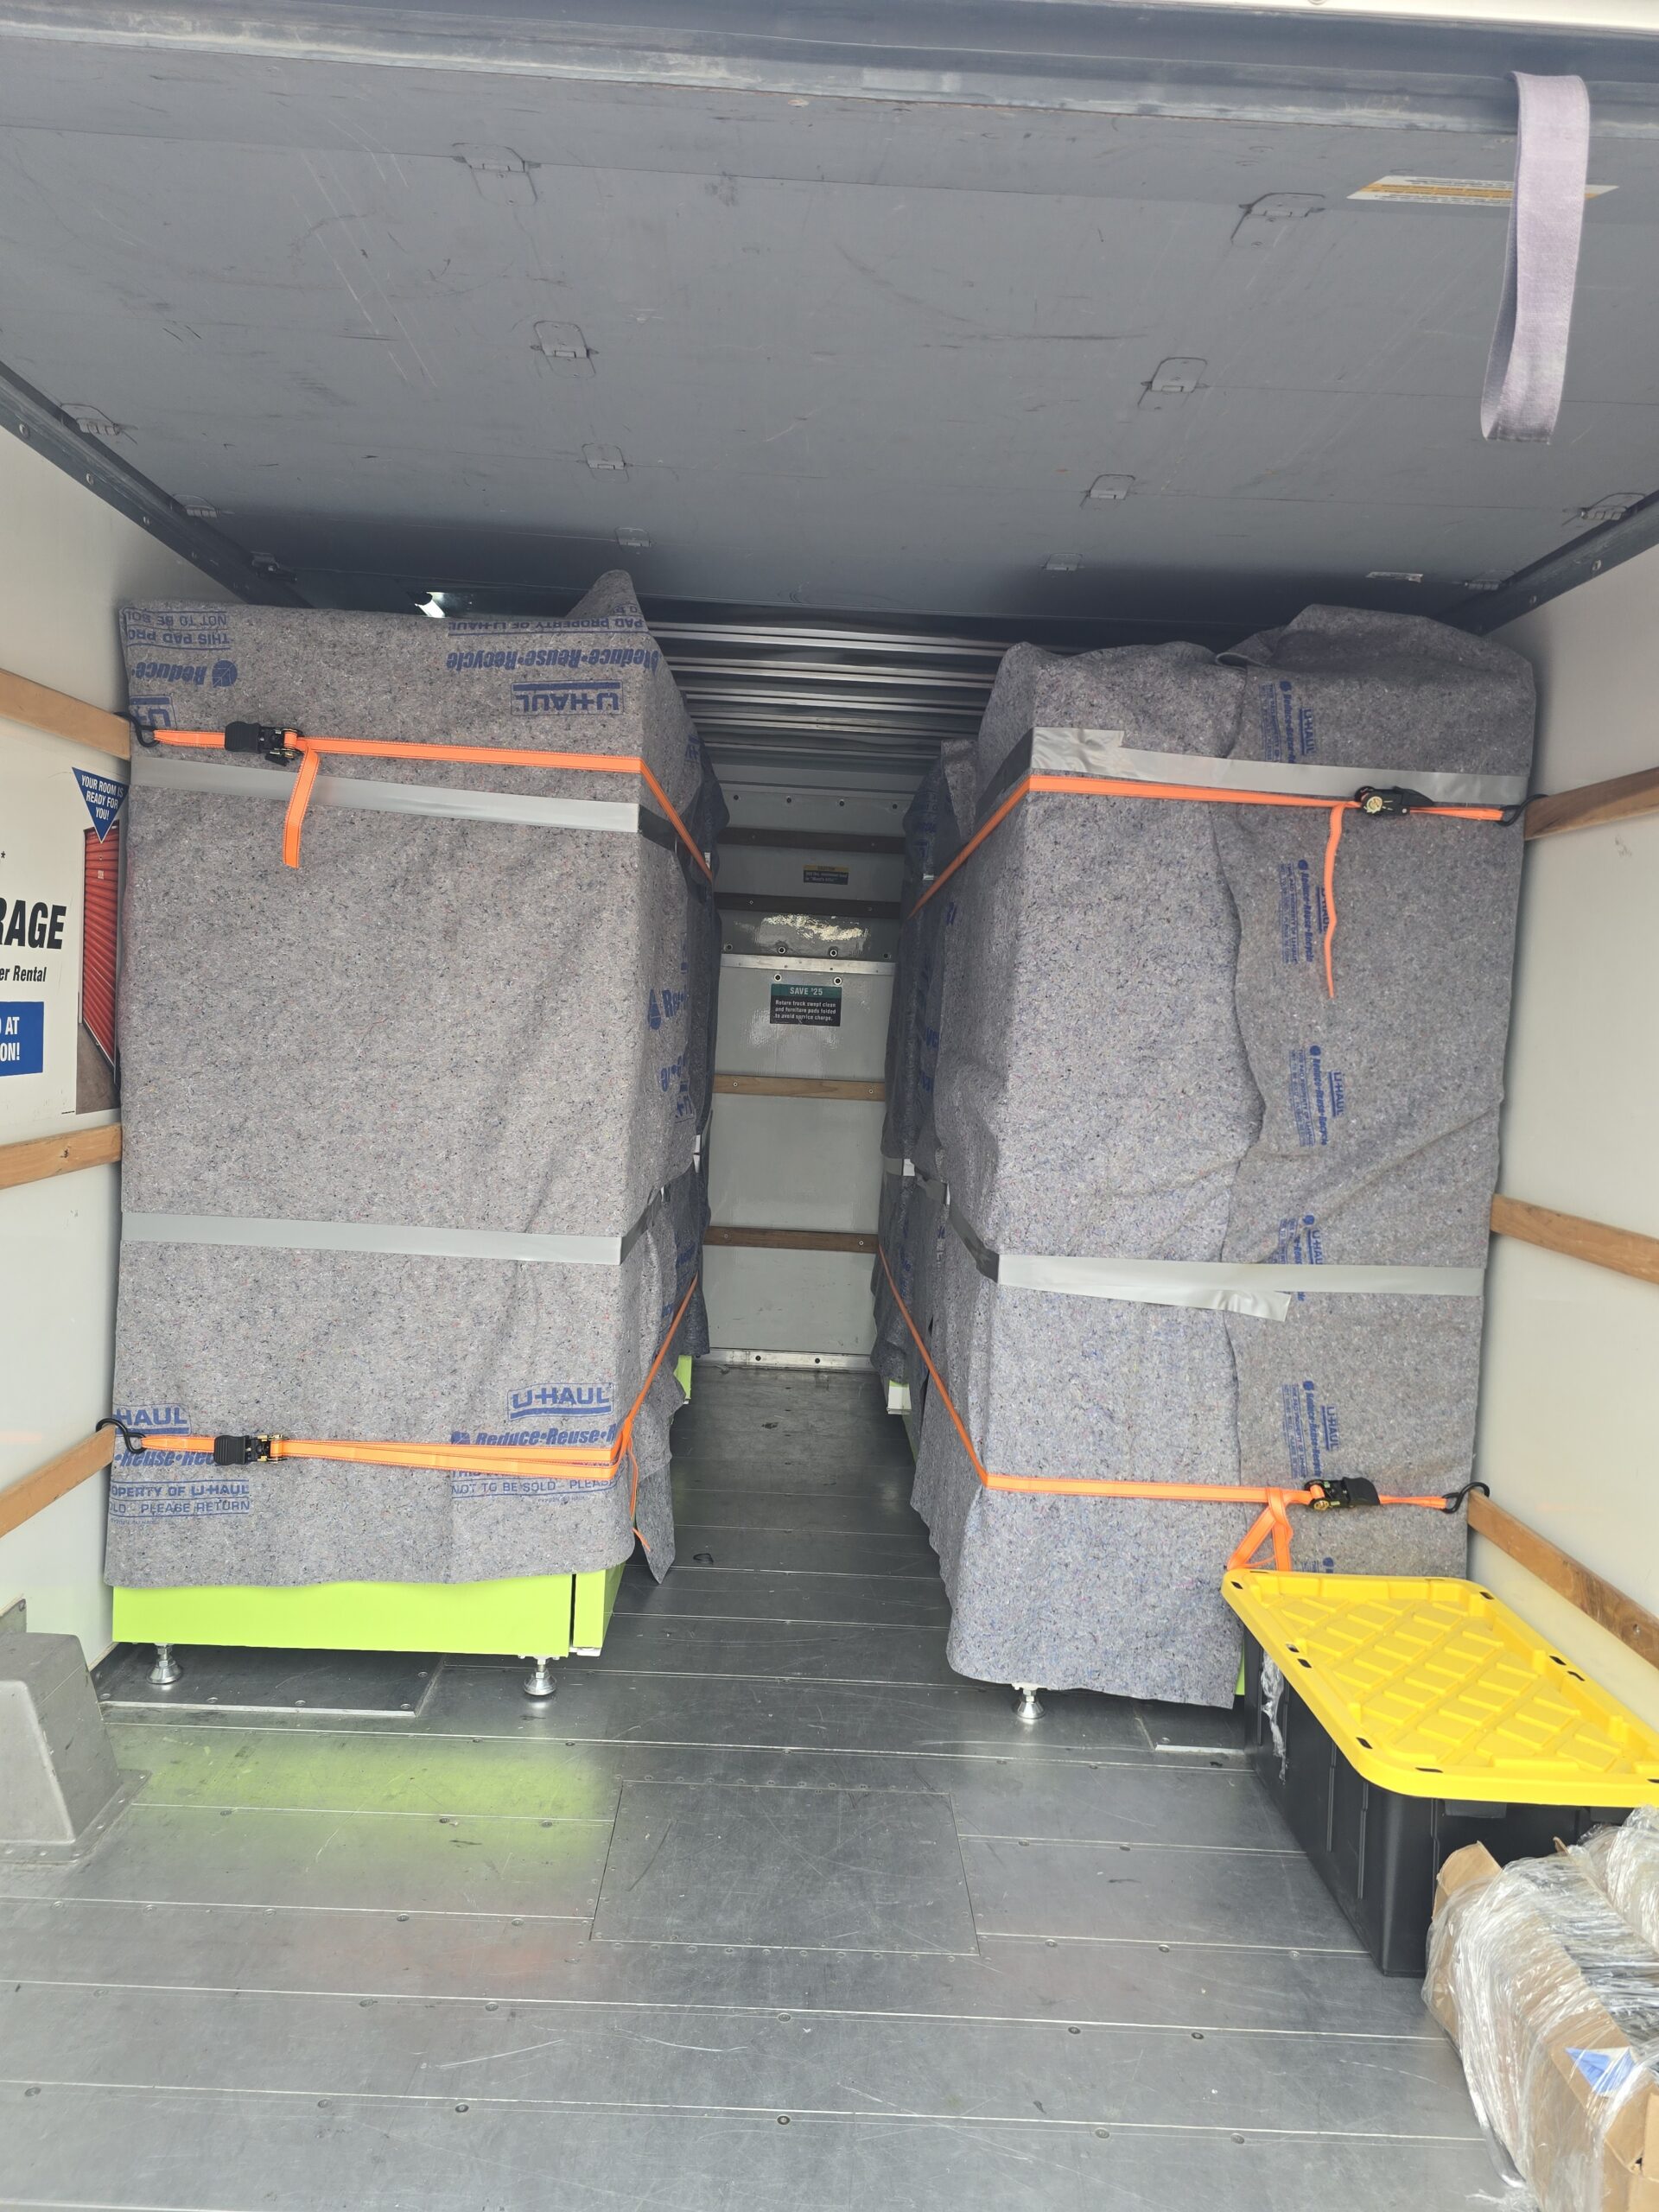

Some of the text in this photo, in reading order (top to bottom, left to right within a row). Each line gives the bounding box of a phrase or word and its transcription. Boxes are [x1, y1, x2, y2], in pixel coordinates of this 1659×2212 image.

[157, 615, 174, 626] BE
[180, 615, 194, 626] TO
[203, 615, 226, 626] NOT
[512, 620, 530, 629] OF
[535, 617, 609, 629] PROPERTY
[614, 617, 643, 629] PAD
[162, 632, 193, 644] PAD
[199, 632, 231, 645] THIS
[516, 693, 620, 713] U-HAUL
[1303, 709, 1317, 754] U-HAUL
[81, 774, 99, 790] YOUR
[99, 780, 117, 796] ROOM
[86, 791, 118, 810] READY FOR
[95, 806, 110, 820] YOU!
[13, 965, 47, 982] Rental
[790, 987, 809, 995] SAVE
[5, 1017, 20, 1035] AT
[1333, 1071, 1344, 1116] U-HAUL
[512, 1387, 610, 1408] U-HAUL
[1326, 1406, 1339, 1449] U-HAUL
[168, 1486, 186, 1497] OF
[191, 1484, 250, 1497] U-HAUL
[451, 1484, 476, 1495] NOT
[481, 1483, 498, 1493] TO
[503, 1483, 518, 1492] BE
[523, 1480, 556, 1492] SOLD
[141, 1503, 190, 1514] PLEASE
[196, 1501, 250, 1513] RETURN
